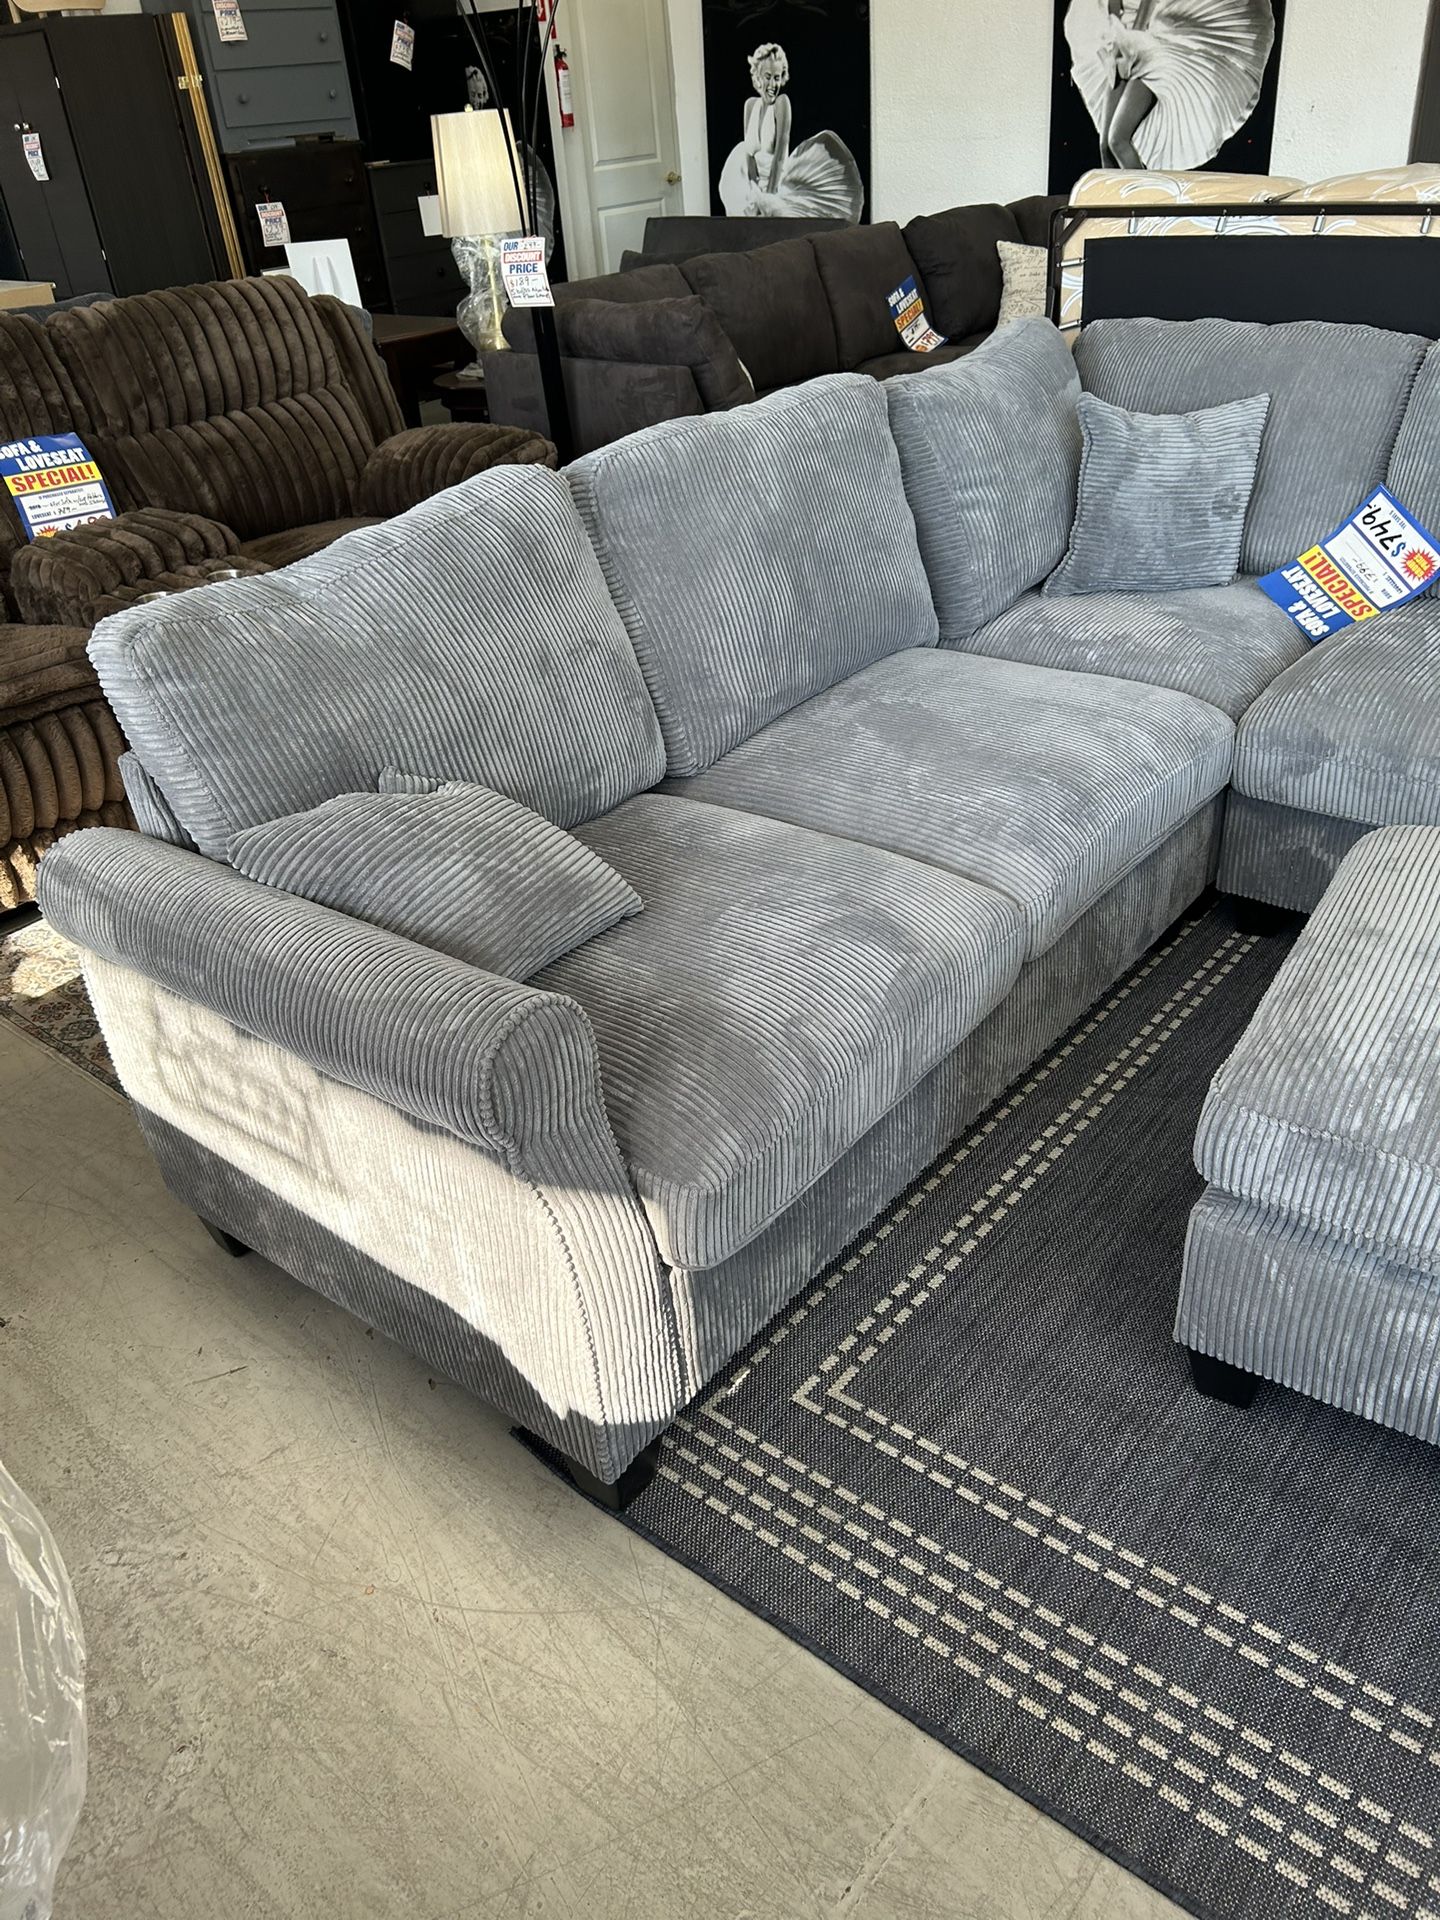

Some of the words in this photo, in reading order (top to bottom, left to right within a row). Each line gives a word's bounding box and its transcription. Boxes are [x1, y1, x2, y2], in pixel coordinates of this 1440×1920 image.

[504, 242, 518, 251] OUR
[505, 252, 541, 262] DISCOUNT
[509, 263, 539, 274] PRICE
[28, 440, 43, 453] &
[15, 447, 87, 471] LOVESEAT
[11, 464, 96, 492] SPECIAL!
[1281, 565, 1341, 619] LOVESEAT
[1303, 551, 1373, 617] SPECIAL!
[1287, 600, 1302, 613] &
[1295, 610, 1330, 636] SOFA
